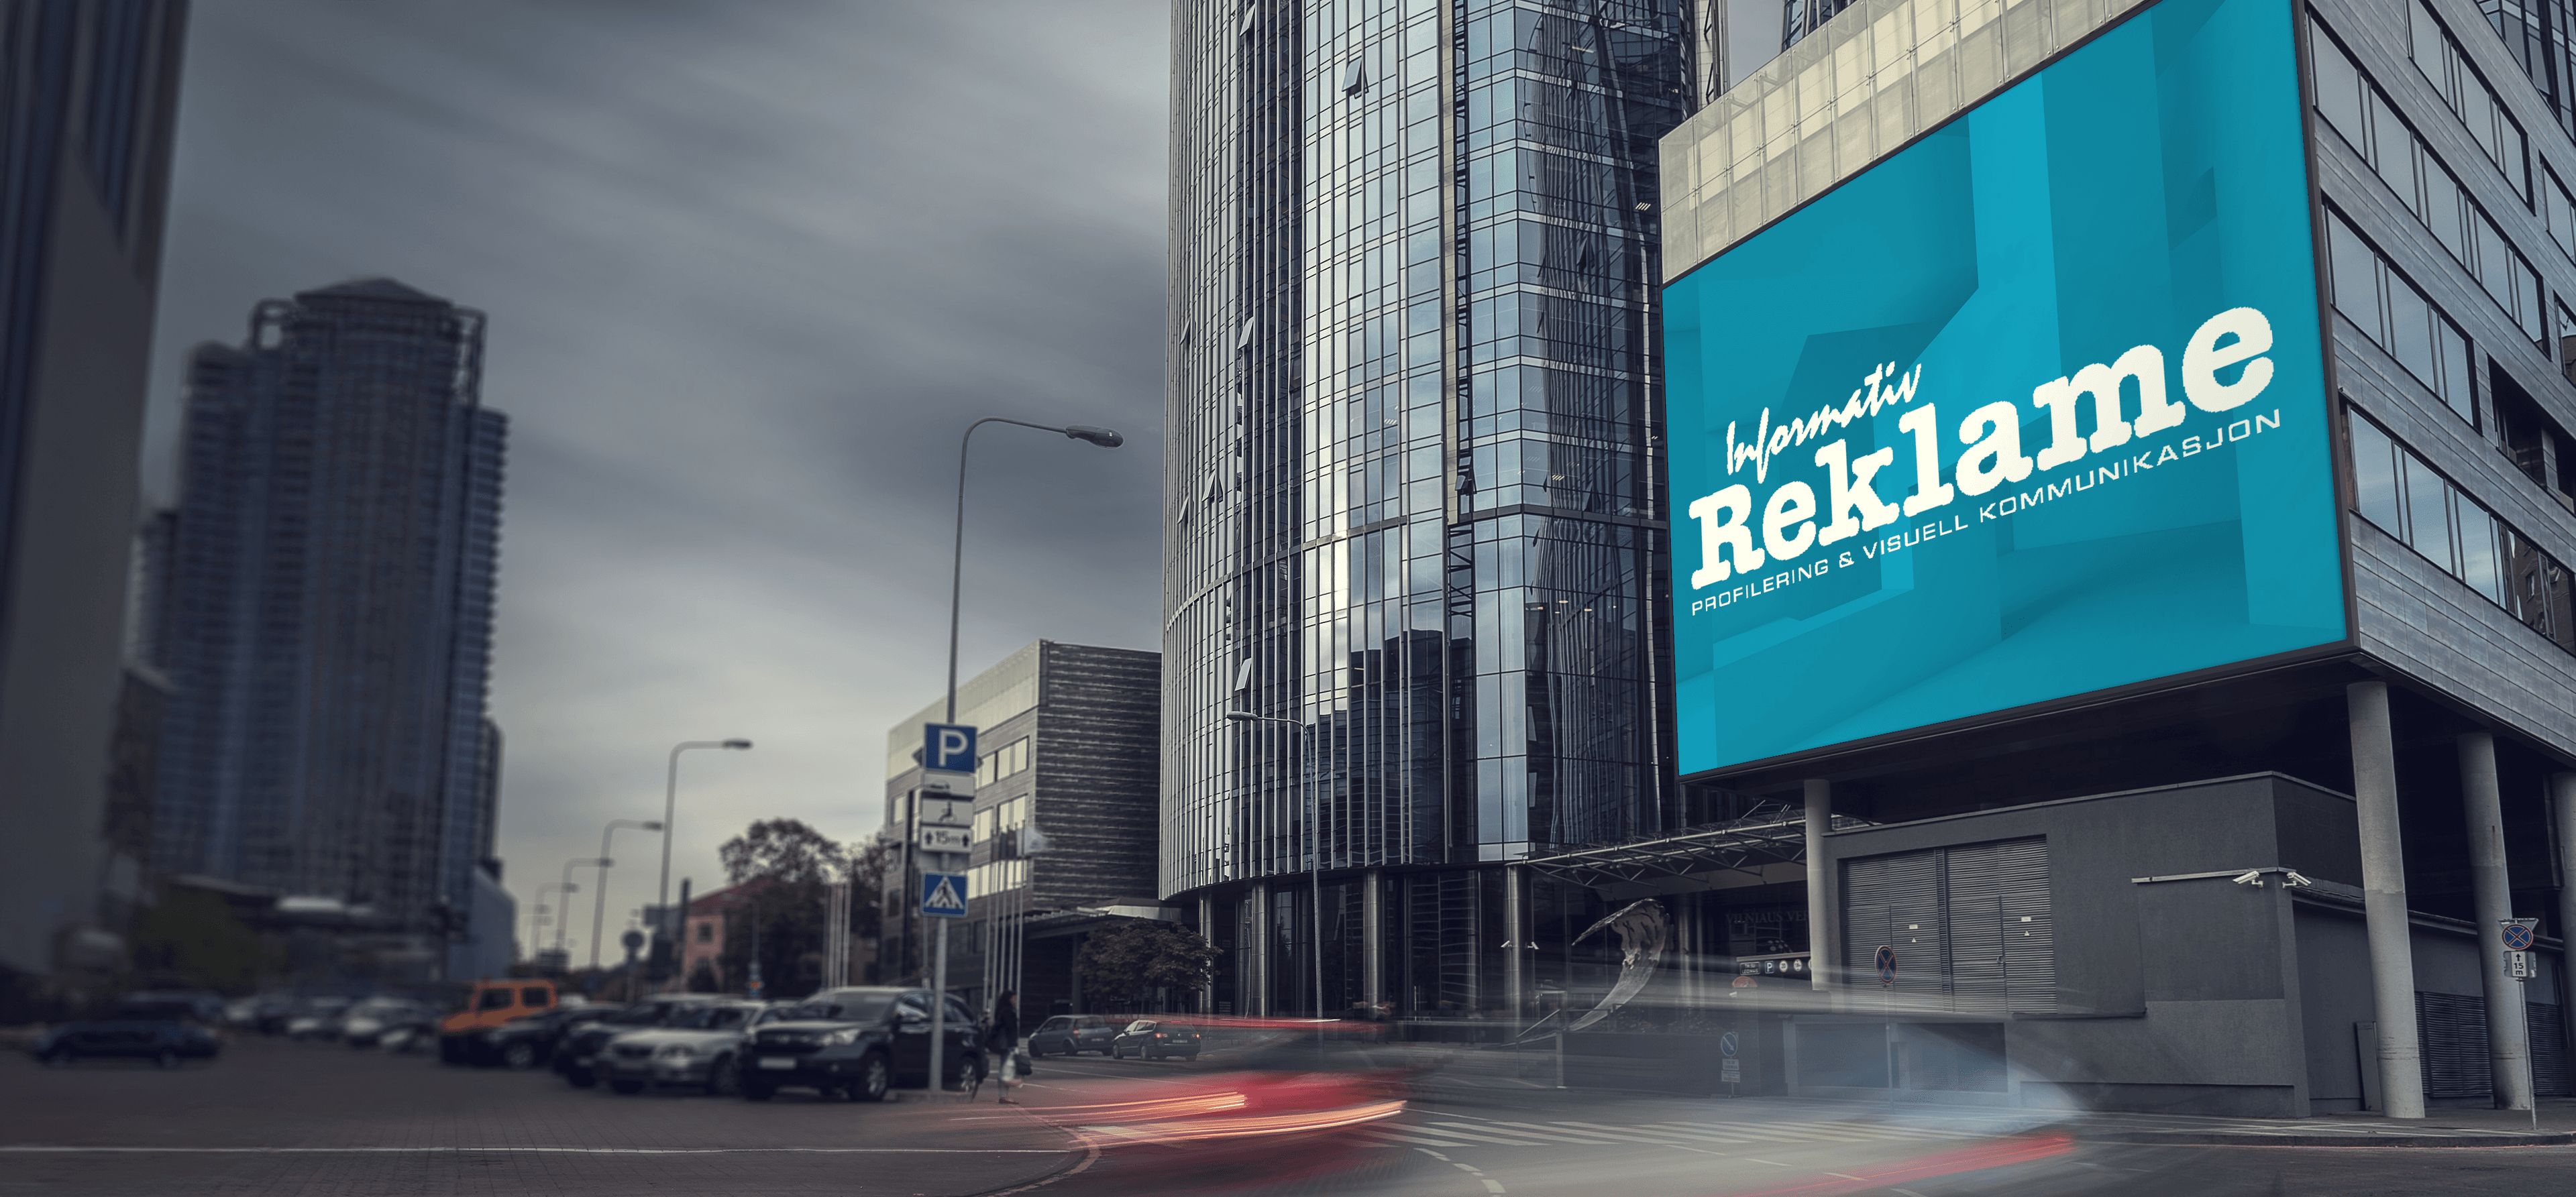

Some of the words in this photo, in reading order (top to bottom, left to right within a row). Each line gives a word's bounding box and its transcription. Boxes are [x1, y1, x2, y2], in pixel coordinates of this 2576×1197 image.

[1688, 306, 2274, 590] Reklame
[1726, 361, 1922, 484] Informativ
[1692, 559, 1829, 616] PROFILERING
[1839, 551, 1855, 569] &
[1862, 515, 1968, 559] VISUELL
[1980, 408, 2280, 523] KOMMUNIKASJON
[939, 729, 969, 767] P
[1725, 911, 1782, 923] VILNIAUS
[1767, 962, 1772, 972] P
